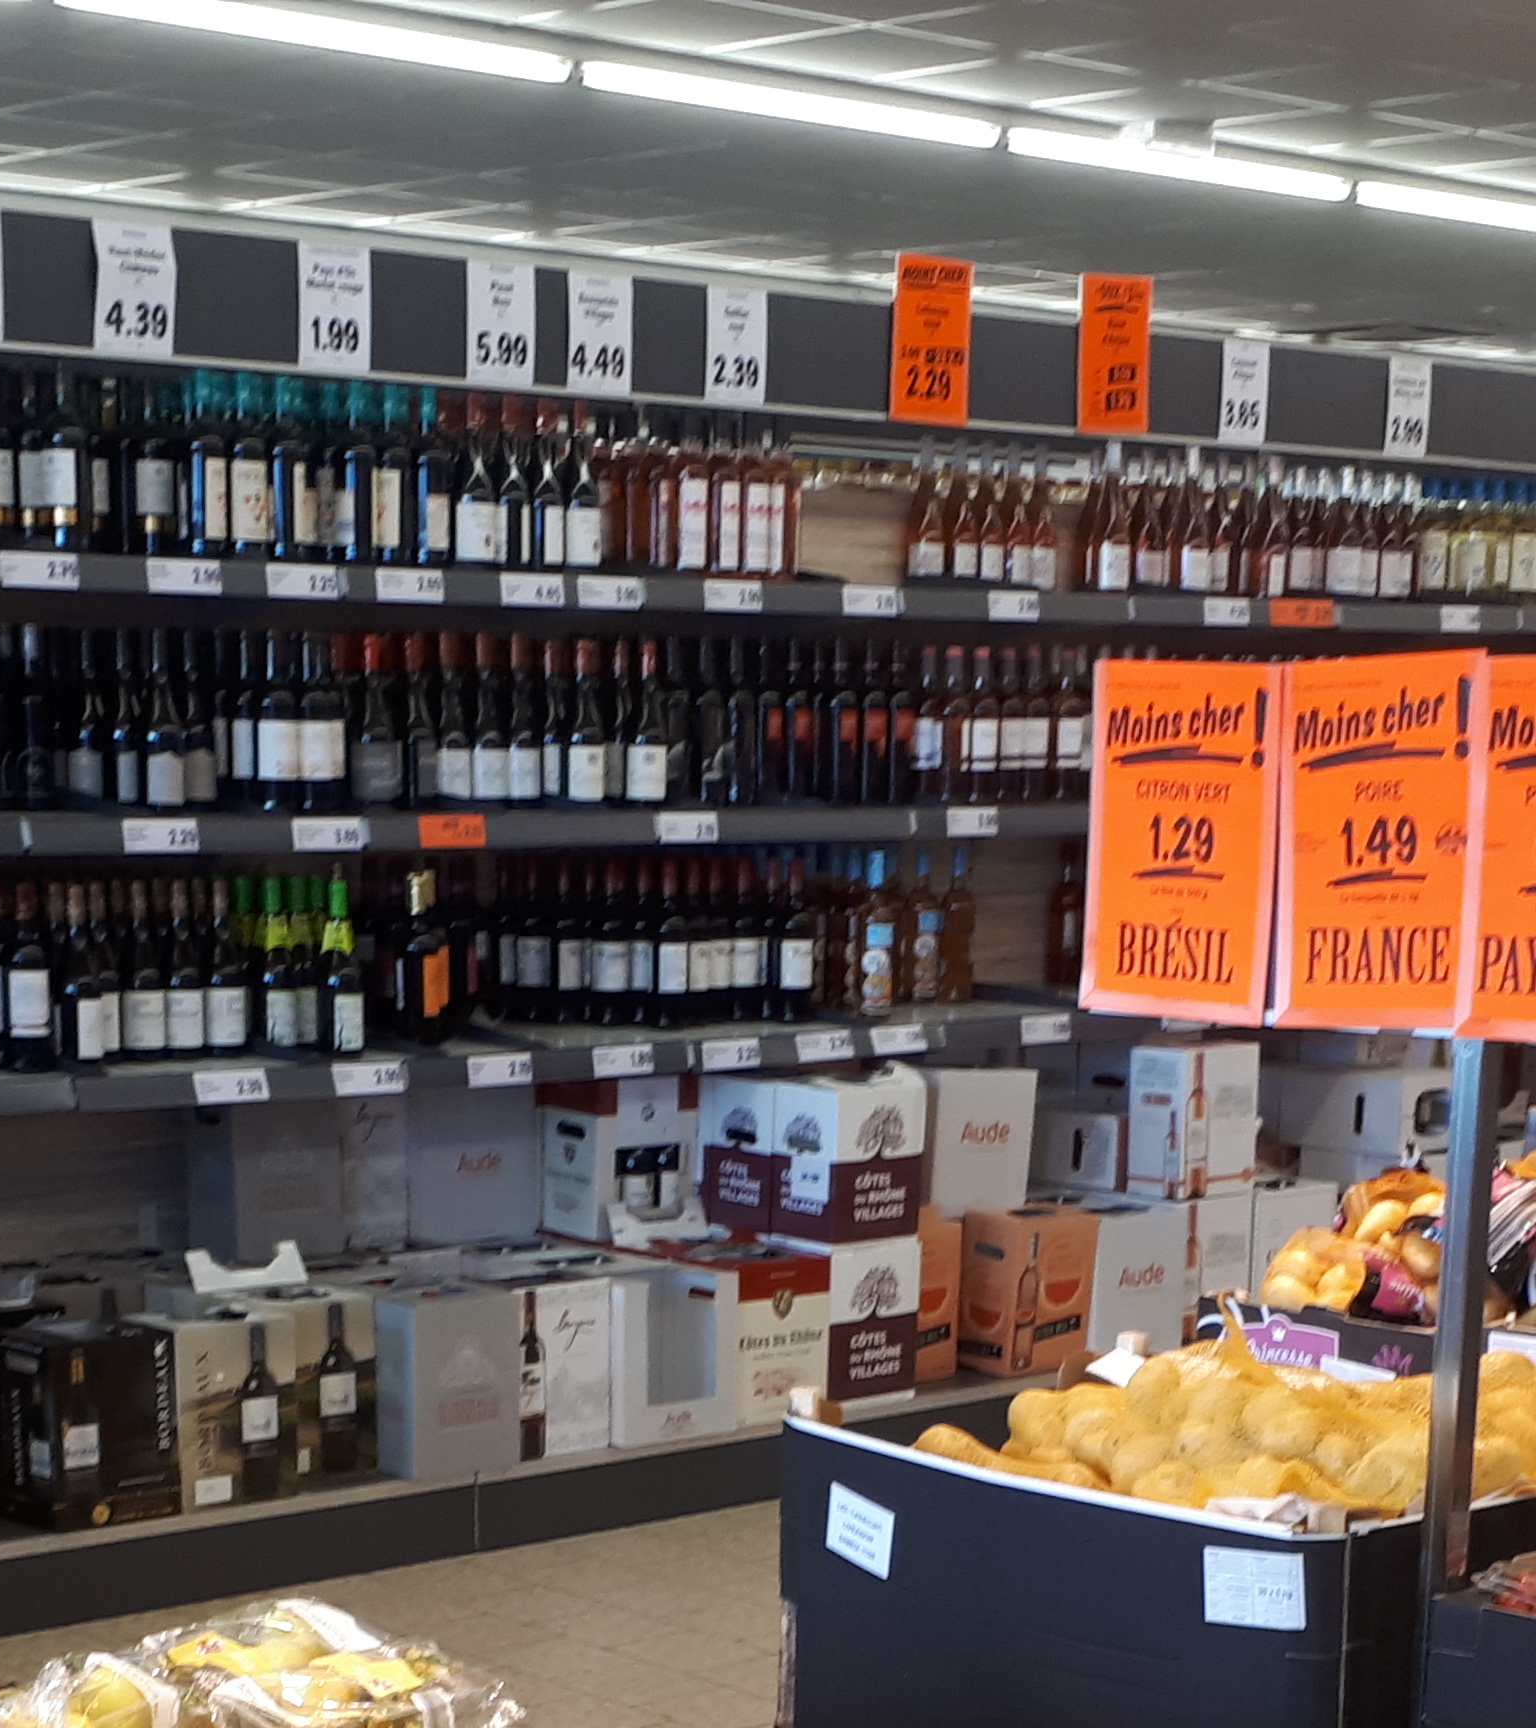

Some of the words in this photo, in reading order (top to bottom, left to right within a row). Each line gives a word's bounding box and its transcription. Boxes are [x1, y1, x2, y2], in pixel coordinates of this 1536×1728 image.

[104, 299, 168, 339] 4.39
[310, 314, 360, 354] 1.99
[475, 330, 528, 368] 5.99
[571, 342, 625, 379] 4.49
[712, 352, 759, 389] 2.39
[904, 364, 951, 402] 2.29
[1106, 702, 1182, 750] Moins
[1188, 694, 1245, 738] cher
[1294, 700, 1376, 754] Moins
[1382, 686, 1445, 740] cher
[1135, 779, 1191, 800] CITRON
[1194, 782, 1231, 803] VERT
[1354, 778, 1403, 801] POIRE
[1148, 814, 1215, 863] 1.29
[1338, 815, 1418, 867] 1.49
[1114, 913, 1234, 985] BRÉSIL
[1305, 925, 1452, 986] FRANCE
[961, 1121, 1010, 1144] Aude
[854, 1171, 892, 1190] CÔTES
[853, 1202, 906, 1223] VILLAGES
[1119, 1262, 1165, 1288] Aude
[849, 1330, 887, 1350] CÔTES
[864, 1344, 903, 1363] RHÔNE
[849, 1361, 902, 1382] VILLAGES
